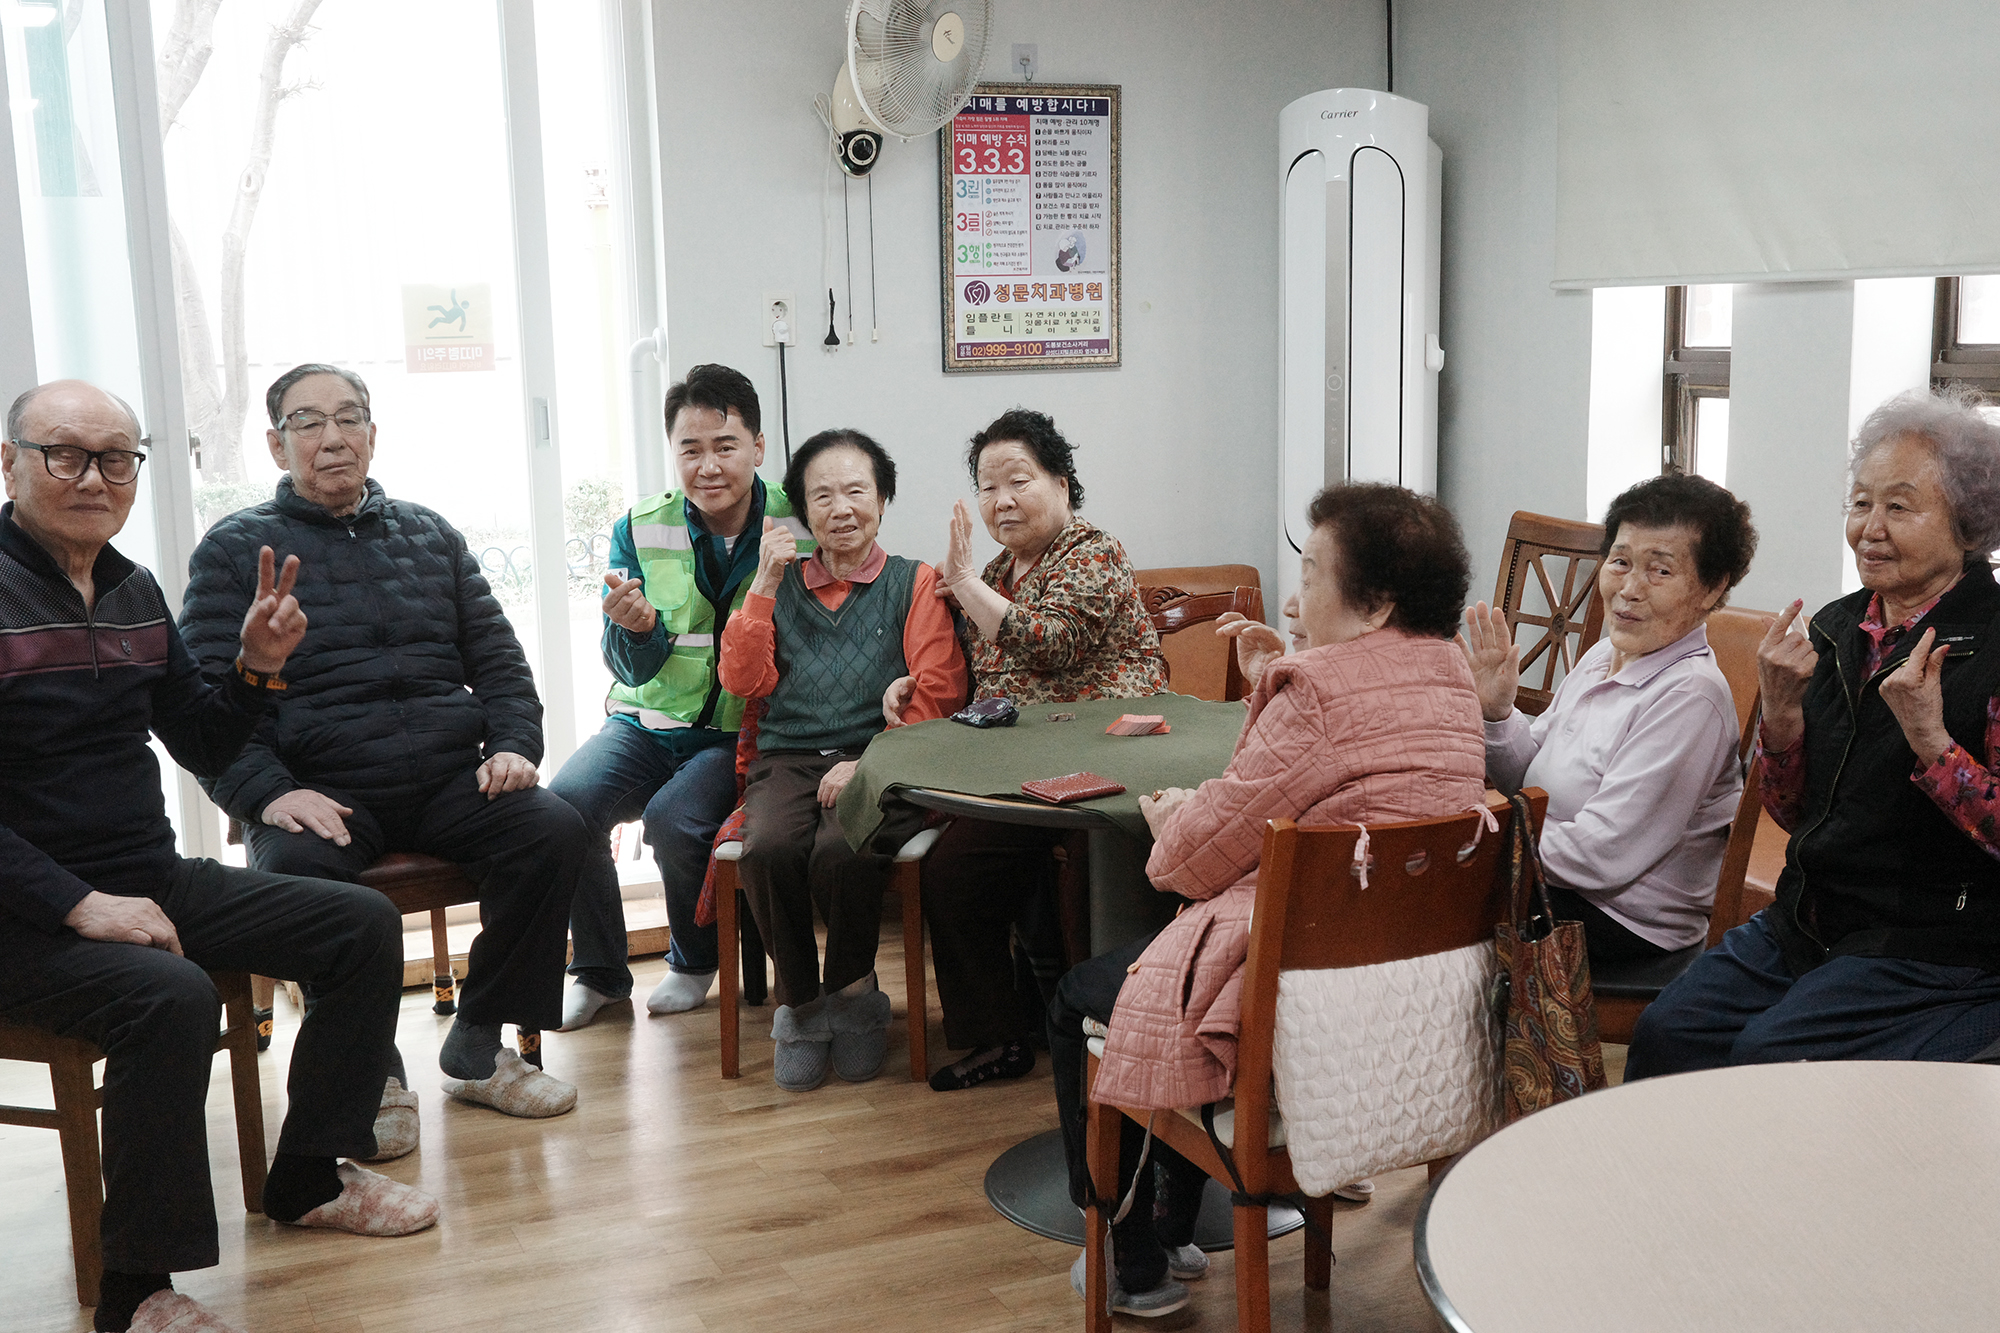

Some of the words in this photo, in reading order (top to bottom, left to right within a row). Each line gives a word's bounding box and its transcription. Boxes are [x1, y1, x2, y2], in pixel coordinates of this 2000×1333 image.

[1016, 98, 1096, 112] 예방합시다!
[1320, 109, 1359, 120] Carrier
[1036, 118, 1048, 126] 치매
[1080, 119, 1100, 127] 10계명
[956, 132, 977, 146] 치매
[981, 133, 1002, 146] 예방
[1006, 133, 1026, 147] 수칙
[959, 148, 1025, 173] 3.3.3
[957, 212, 980, 231] 3금
[957, 244, 980, 263] 3행
[994, 282, 1103, 302] 성문치과병원
[966, 312, 1014, 324] 임플란트
[972, 343, 1042, 356] 02)999-9100
